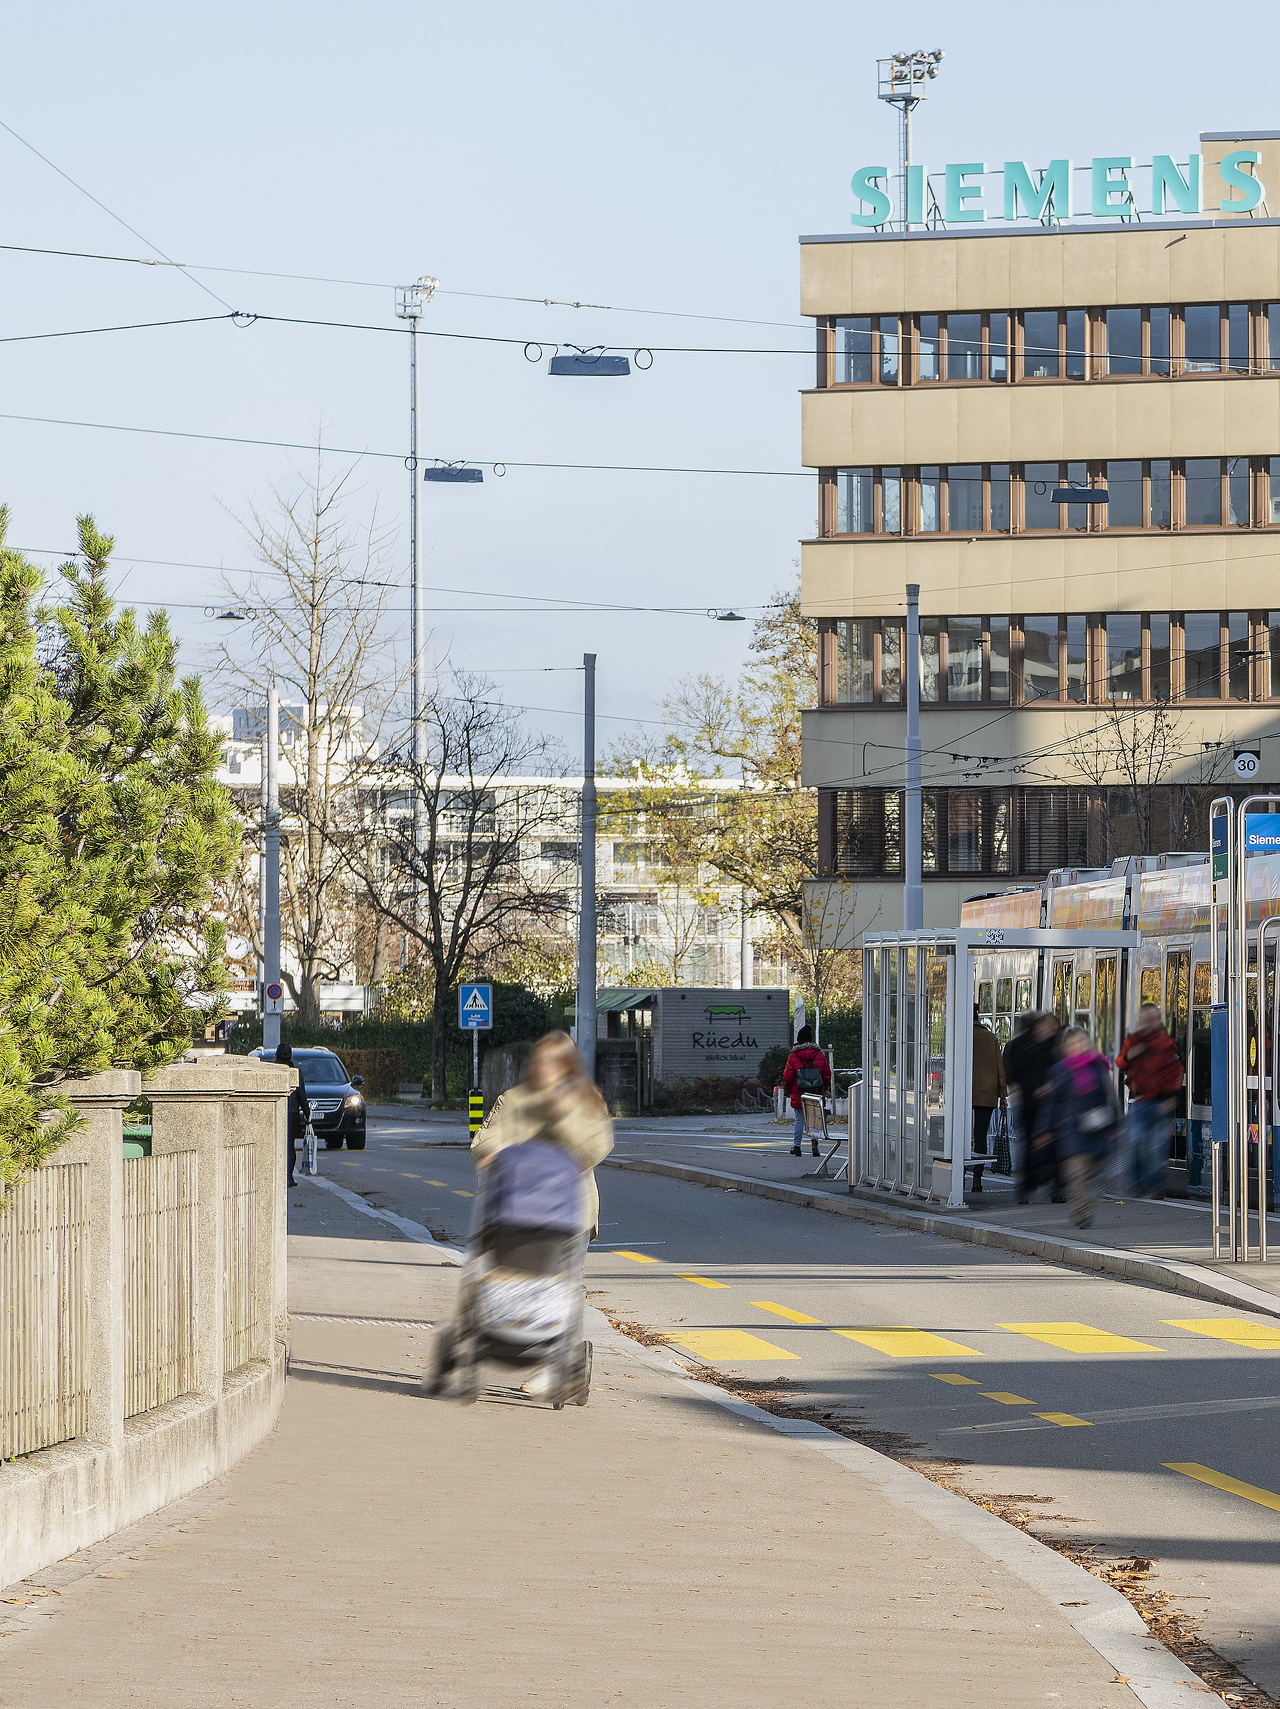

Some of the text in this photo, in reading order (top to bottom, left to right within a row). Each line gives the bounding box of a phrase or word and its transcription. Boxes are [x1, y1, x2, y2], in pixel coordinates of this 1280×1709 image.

[850, 150, 1266, 227] SIEMENS
[1237, 759, 1256, 771] 30
[692, 1031, 758, 1048] Rüedu
